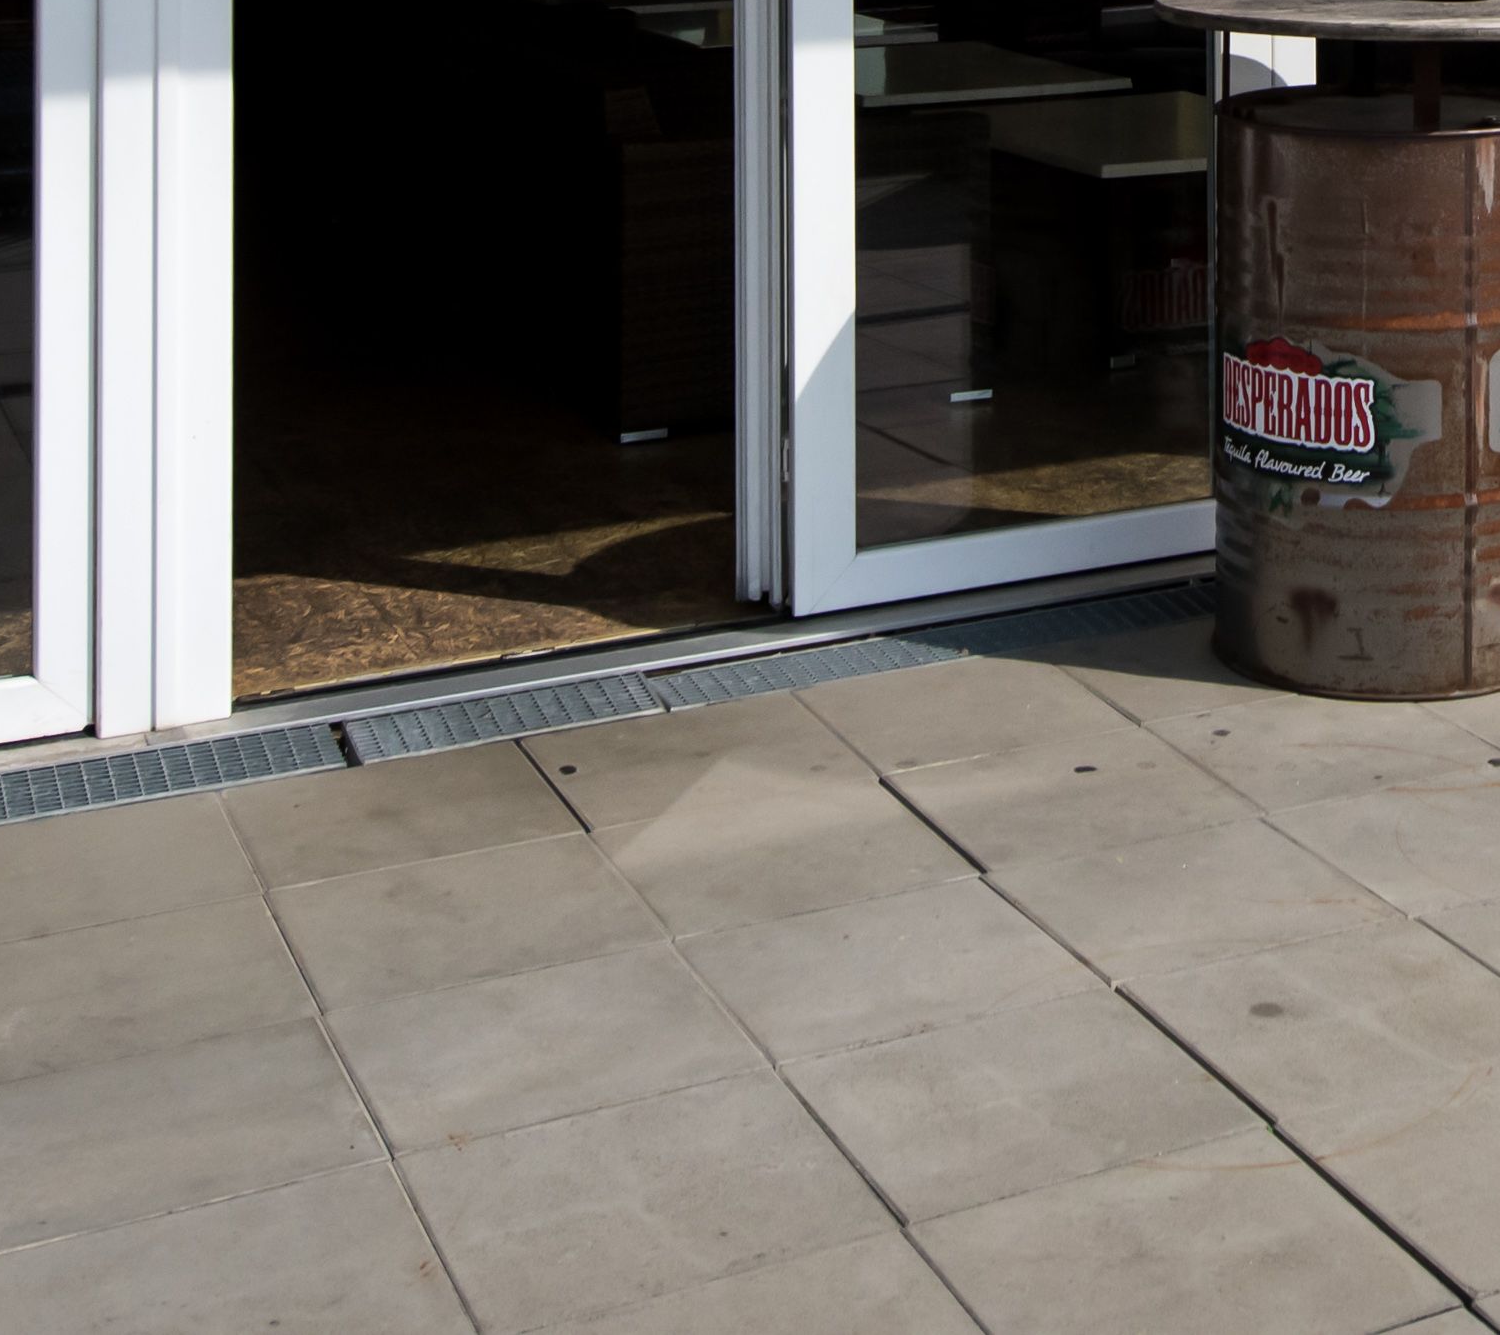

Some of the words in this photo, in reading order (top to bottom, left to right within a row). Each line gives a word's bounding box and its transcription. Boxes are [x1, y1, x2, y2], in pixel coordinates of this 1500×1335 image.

[1224, 354, 1372, 449] DESPERADOS
[1224, 435, 1252, 463] Tequila
[1255, 449, 1326, 479] flavoured
[1328, 463, 1370, 483] Beer
